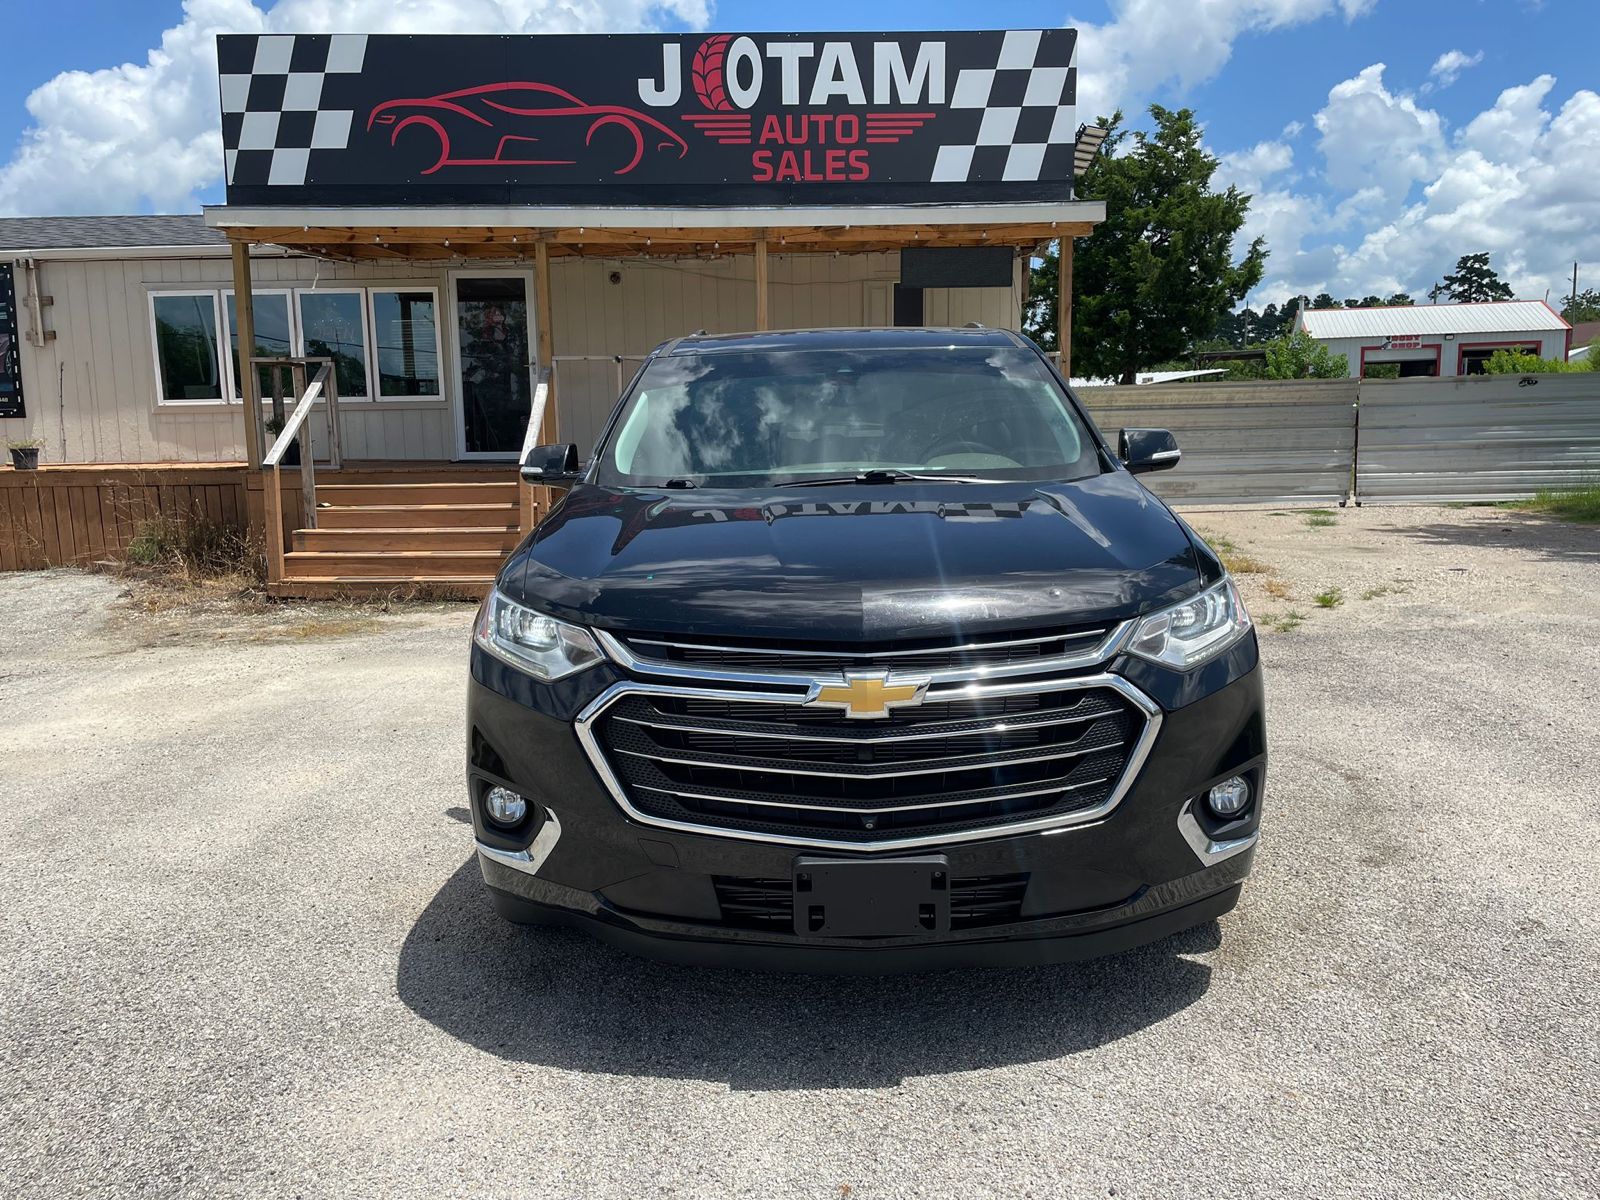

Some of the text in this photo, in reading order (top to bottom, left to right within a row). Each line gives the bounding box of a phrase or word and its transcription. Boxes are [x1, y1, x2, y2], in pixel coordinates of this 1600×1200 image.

[637, 36, 947, 110] JOTAM
[759, 114, 860, 145] AUTO
[752, 149, 870, 182] SALES
